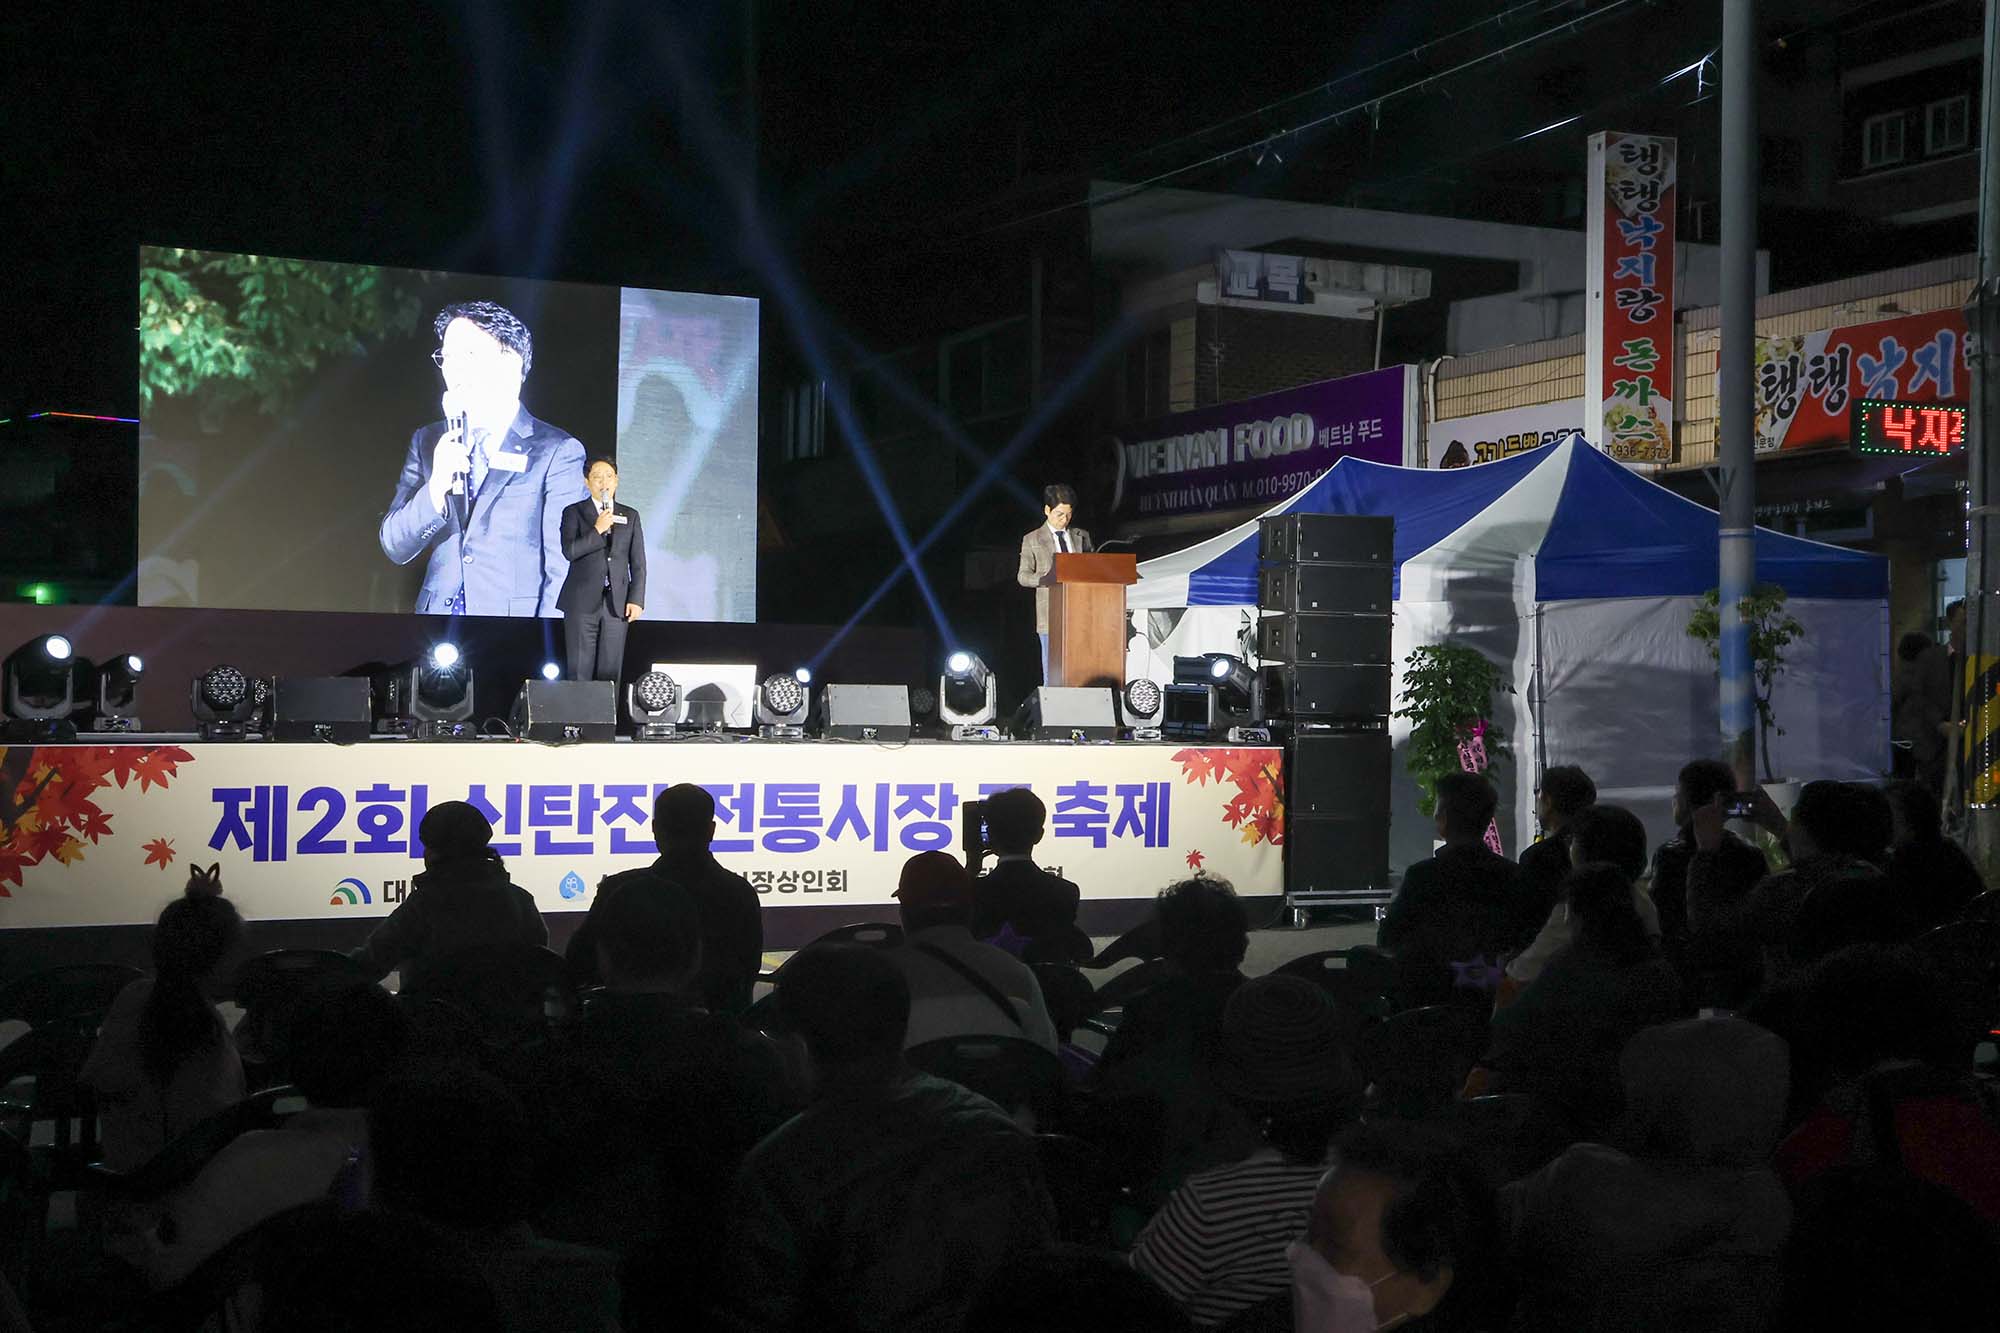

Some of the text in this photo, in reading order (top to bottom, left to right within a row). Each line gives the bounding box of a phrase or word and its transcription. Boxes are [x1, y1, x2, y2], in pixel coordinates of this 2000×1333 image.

[1614, 337, 1660, 441] 돈까스
[1760, 329, 1971, 424] 탱탱낙지
[1234, 412, 1314, 462] FOOD
[1319, 418, 1383, 448] 베트남 푸드
[209, 784, 427, 862] 제2회
[1052, 780, 1171, 848] 축제
[743, 869, 848, 894] 장상인회
